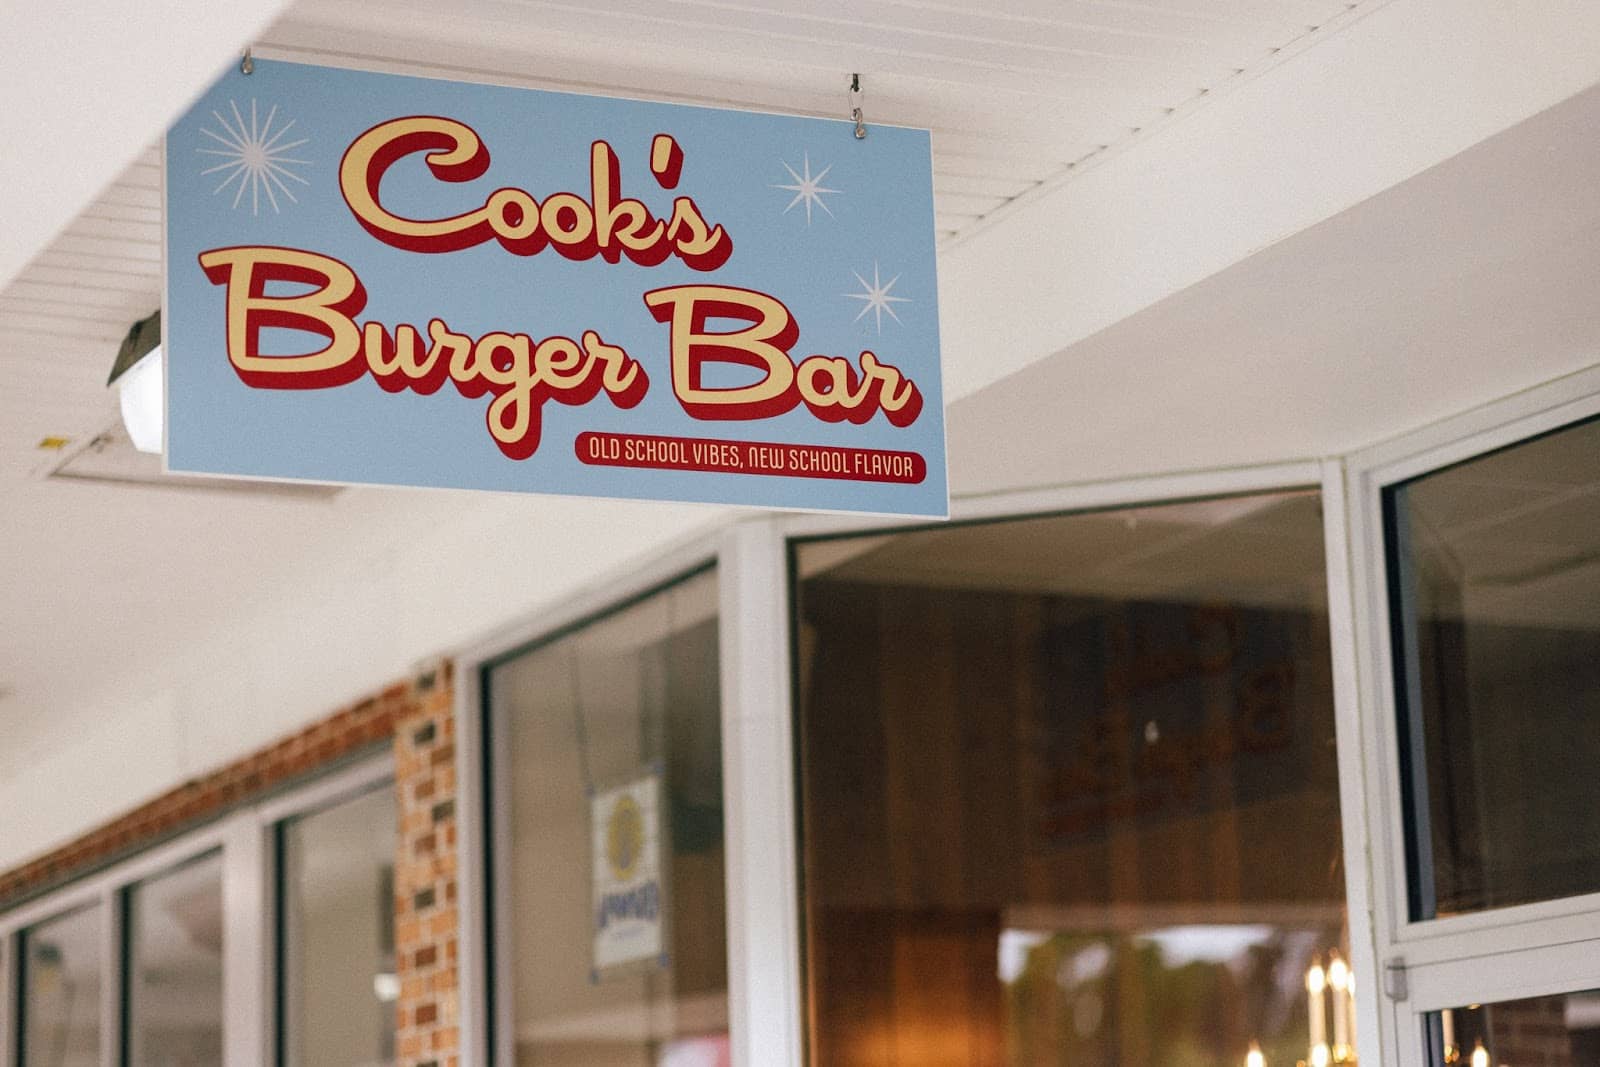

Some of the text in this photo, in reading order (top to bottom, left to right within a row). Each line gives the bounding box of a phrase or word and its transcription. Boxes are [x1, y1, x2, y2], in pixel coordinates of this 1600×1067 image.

[339, 115, 732, 271] Cook's
[198, 246, 924, 460] Burger Bar
[589, 436, 914, 478] OLD SCHOOL VIBES, NEW SCHOOL FLAVOR
